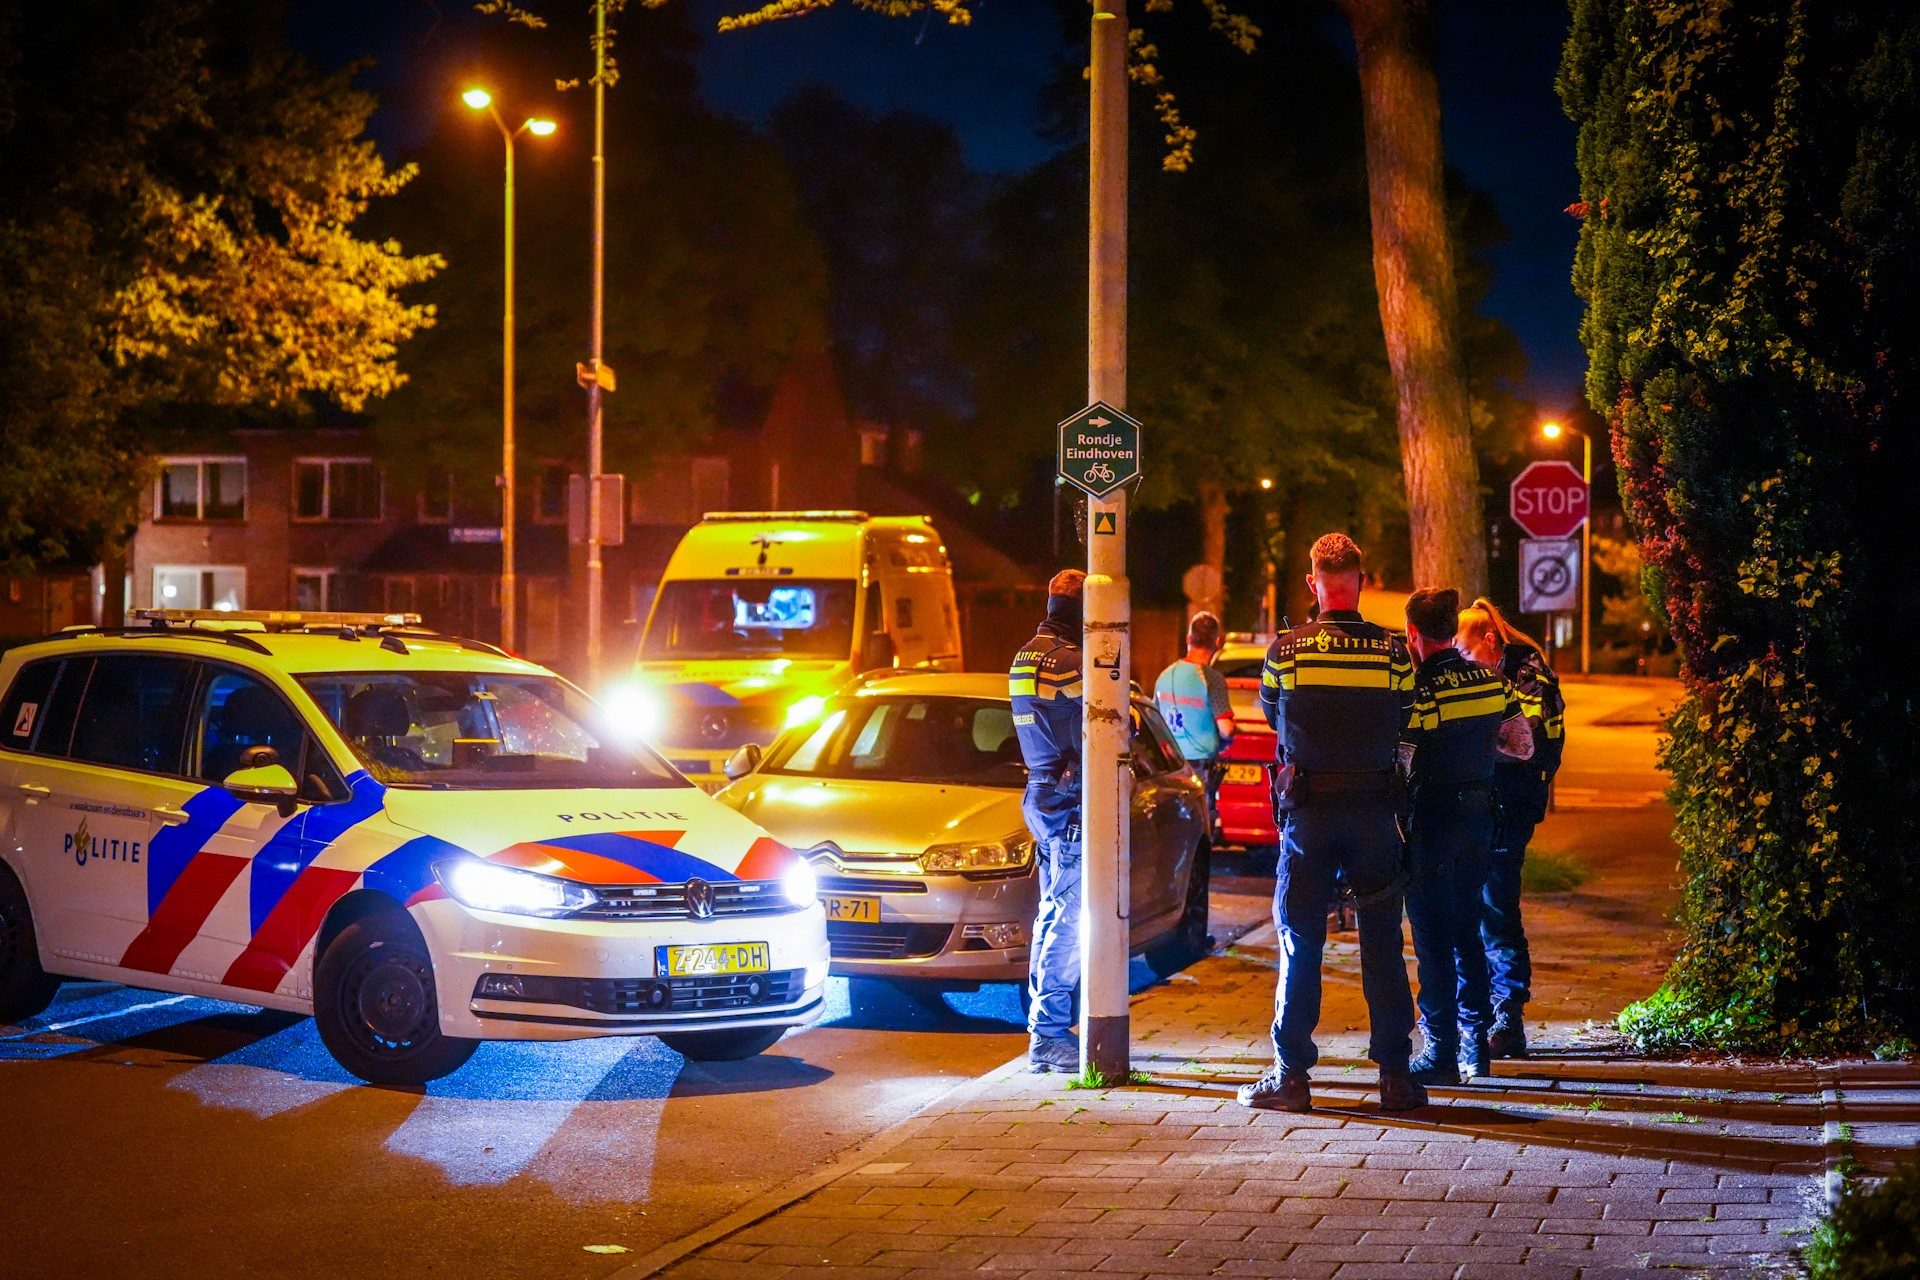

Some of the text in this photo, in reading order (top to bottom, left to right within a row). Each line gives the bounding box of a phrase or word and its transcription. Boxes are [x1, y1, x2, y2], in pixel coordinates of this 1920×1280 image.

[1077, 434, 1122, 448] Rondje
[1066, 448, 1134, 459] Eindhoven
[1517, 487, 1585, 515] STOP
[1306, 637, 1381, 653] POLITIE
[1437, 668, 1496, 688] POLITIE
[557, 811, 689, 823] POLITIE
[64, 833, 141, 866] POLITIE
[674, 946, 764, 972] Z-244-DH
